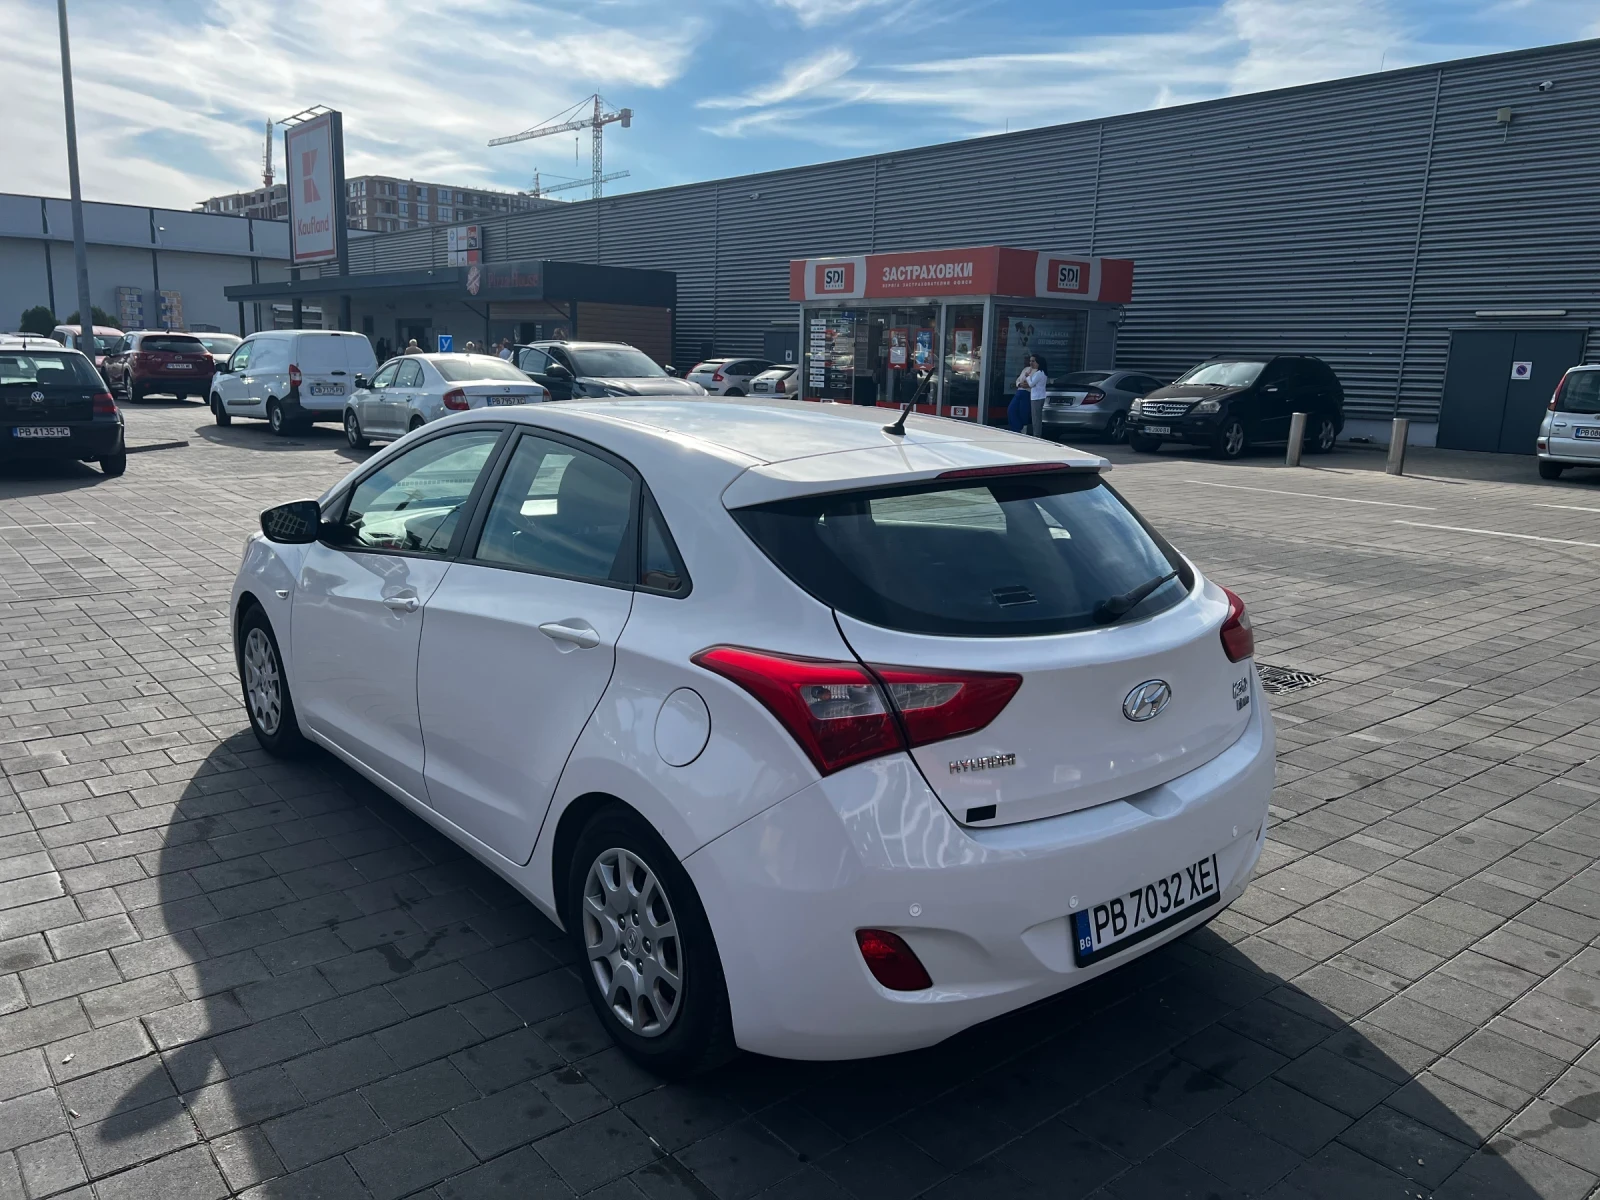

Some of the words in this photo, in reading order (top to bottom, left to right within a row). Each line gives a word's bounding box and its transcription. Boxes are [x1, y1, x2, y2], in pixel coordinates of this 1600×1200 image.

[297, 213, 330, 236] Kaufland
[825, 269, 844, 284] SDI
[882, 262, 973, 281] ЗАСТРАХОВКИ
[1059, 267, 1079, 283] SDI
[19, 428, 31, 436] PB
[33, 428, 55, 436] 4135
[949, 753, 1016, 774] HYUNDAI
[1093, 898, 1128, 944] PB
[1129, 872, 1185, 929] 7032
[1185, 857, 1214, 900] XE
[1079, 936, 1092, 950] BG
